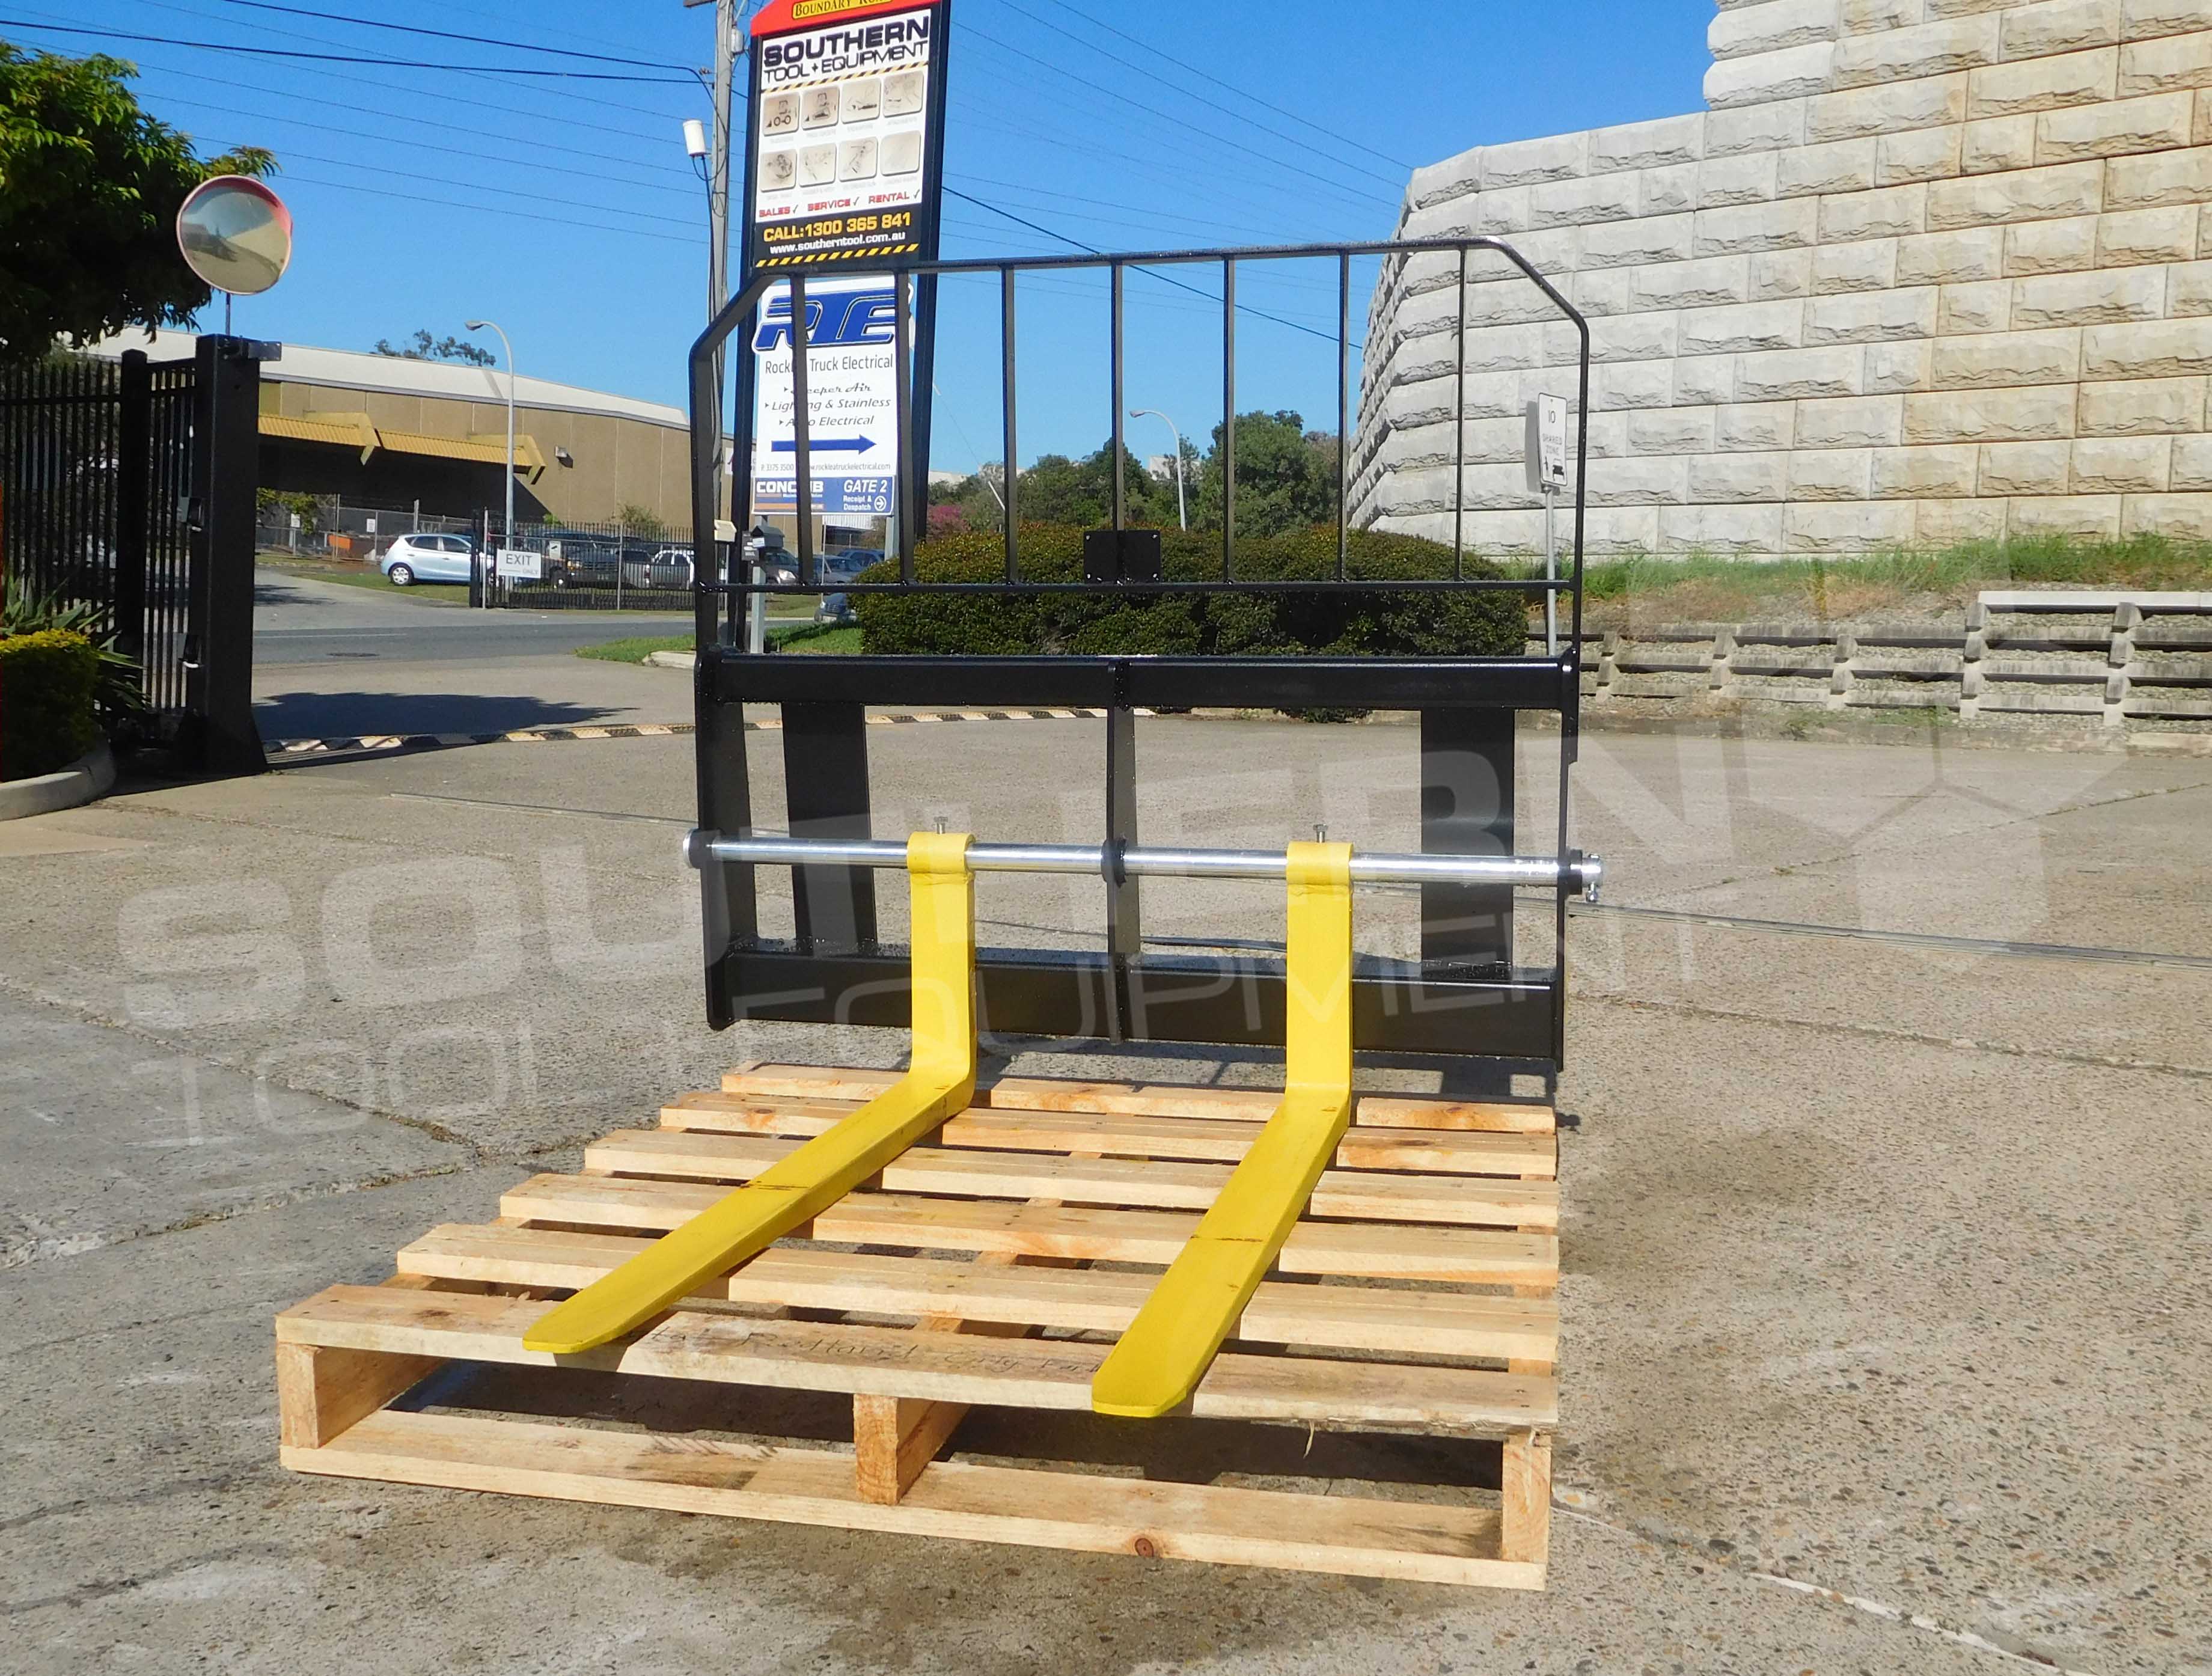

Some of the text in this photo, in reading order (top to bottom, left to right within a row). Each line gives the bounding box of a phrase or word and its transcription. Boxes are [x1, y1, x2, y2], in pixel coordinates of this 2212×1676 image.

[764, 16, 929, 67] SOUTHERN
[821, 40, 928, 73] EQUIPMENT
[759, 192, 909, 217] SALES SERVICE RENTAL
[846, 216, 878, 232] 365
[882, 212, 911, 228] 841
[770, 231, 906, 254] www.southerntool.com.au
[765, 353, 894, 374] Rock Truck Electrical
[845, 382, 873, 393] Air
[825, 399, 834, 409] &
[837, 398, 892, 409] Stainless
[785, 415, 875, 427] Ao Electrical
[844, 480, 878, 493] GATE
[880, 480, 888, 493] 2
[506, 554, 533, 566] EXIT
